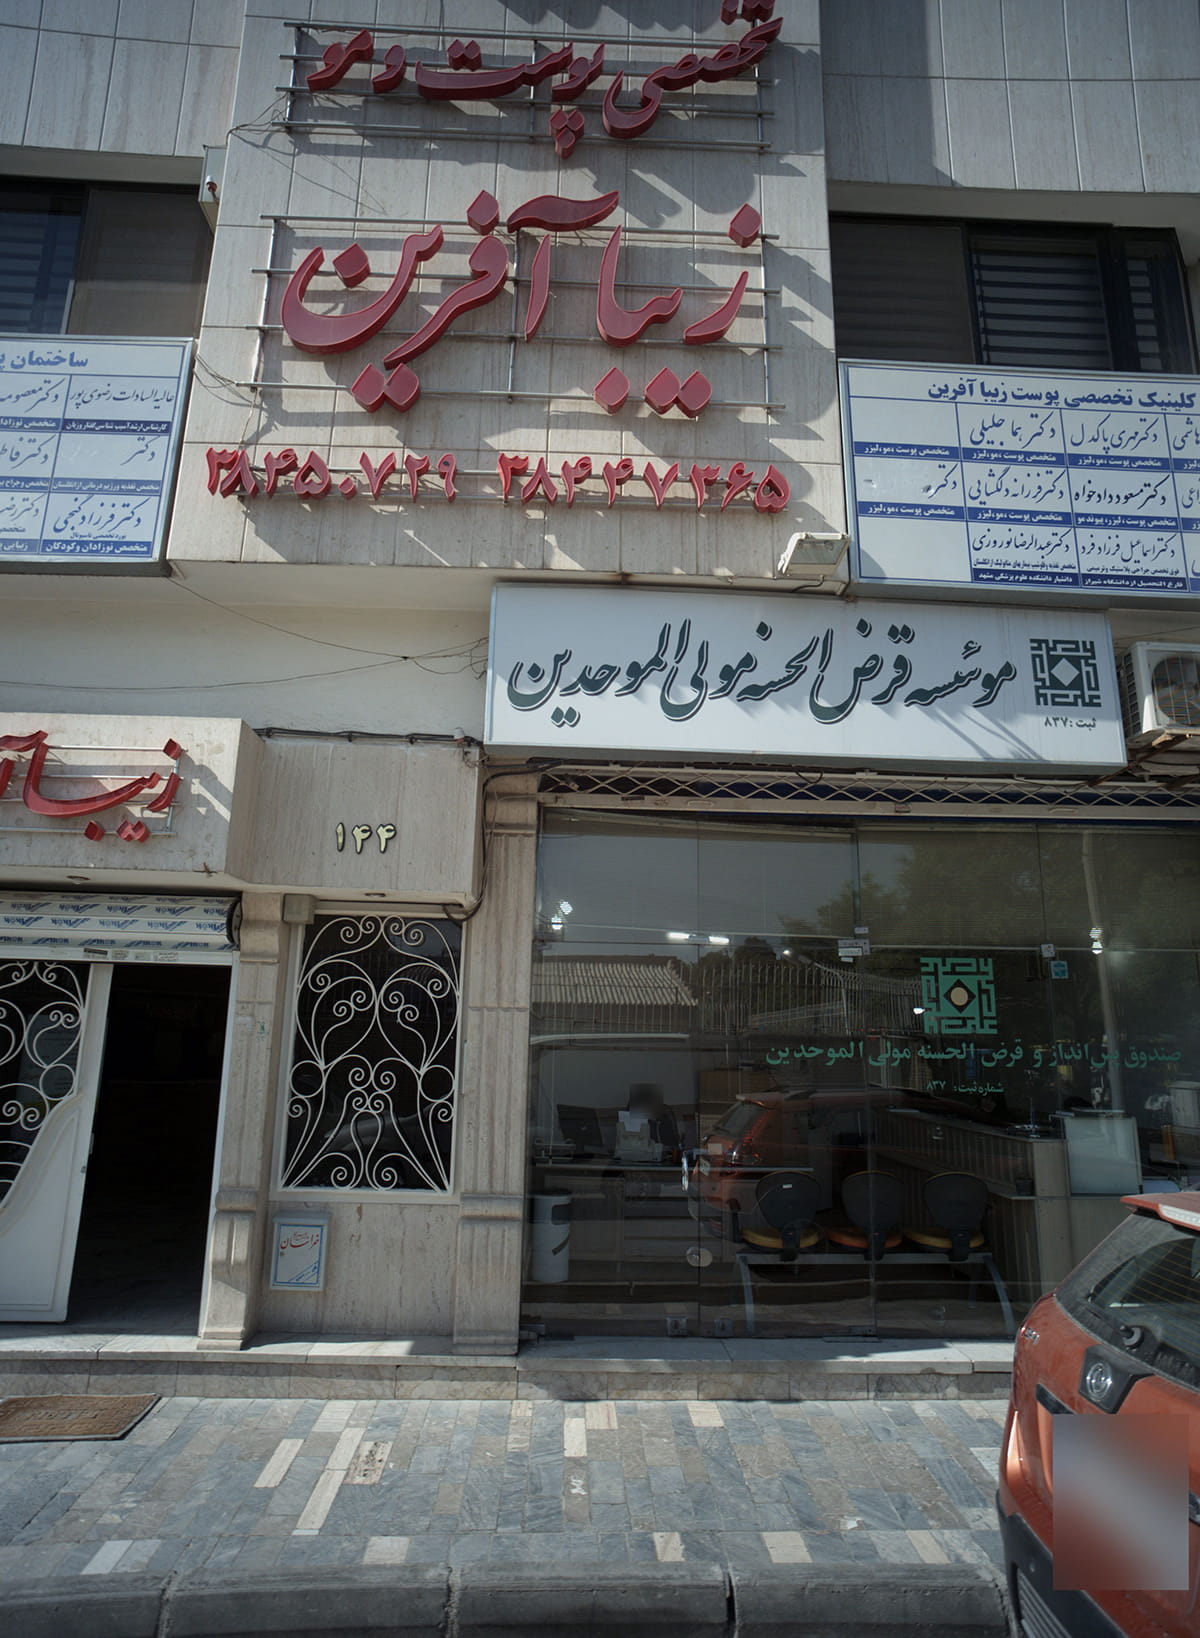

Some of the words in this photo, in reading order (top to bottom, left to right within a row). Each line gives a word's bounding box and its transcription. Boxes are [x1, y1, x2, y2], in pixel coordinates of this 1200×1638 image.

[306, 29, 374, 92] مو
[372, 44, 406, 93] و
[416, 39, 606, 159] پوست
[281, 189, 620, 414] آفرین
[594, 203, 762, 418] زیبا
[10, 350, 88, 369] ساختمان
[0, 387, 43, 403] معصوم
[24, 377, 65, 413] دکتر
[928, 377, 977, 401] آفرین
[980, 381, 1007, 403] زیبا
[1011, 387, 1060, 407] پوست
[1064, 388, 1133, 408] تخصصی
[1138, 391, 1196, 412] کلینیک
[0, 418, 23, 428] نوزادا
[970, 413, 1006, 446] جلیلی
[1021, 411, 1056, 450] دکتر
[1130, 417, 1159, 452] دکتر
[11, 434, 56, 469] دکتر
[120, 435, 160, 466] دکتر
[206, 448, 457, 503] ۳۸۴۵۰۷۲۹
[498, 452, 791, 514] ۳۸۴۴۷۳۶۵
[928, 463, 958, 499] دکتر
[1035, 468, 1066, 504] دکتر
[1137, 473, 1170, 510] دکتر
[11, 493, 47, 521] دکتر
[1114, 488, 1144, 505] مسعود
[78, 502, 115, 531] فرزاد
[108, 496, 151, 533] دکتر
[114, 543, 148, 553] متخصص
[1045, 528, 1072, 556] دکتر
[1152, 533, 1177, 561] دکتر
[507, 617, 692, 728] الموحدین
[736, 620, 833, 702] الحسنه
[809, 617, 914, 724] قرض
[660, 639, 758, 722] مولی
[23, 738, 183, 843] زیبا
[335, 821, 397, 854] ۱۴۴
[766, 1041, 864, 1065] الموحدین
[868, 1041, 912, 1066] مولی
[917, 1041, 975, 1060] الحسنه
[981, 1037, 1024, 1067] قرض
[1032, 1050, 1043, 1068] و
[1124, 1045, 1182, 1069] صندوق
[926, 1080, 946, 1091] ۸۳۷
